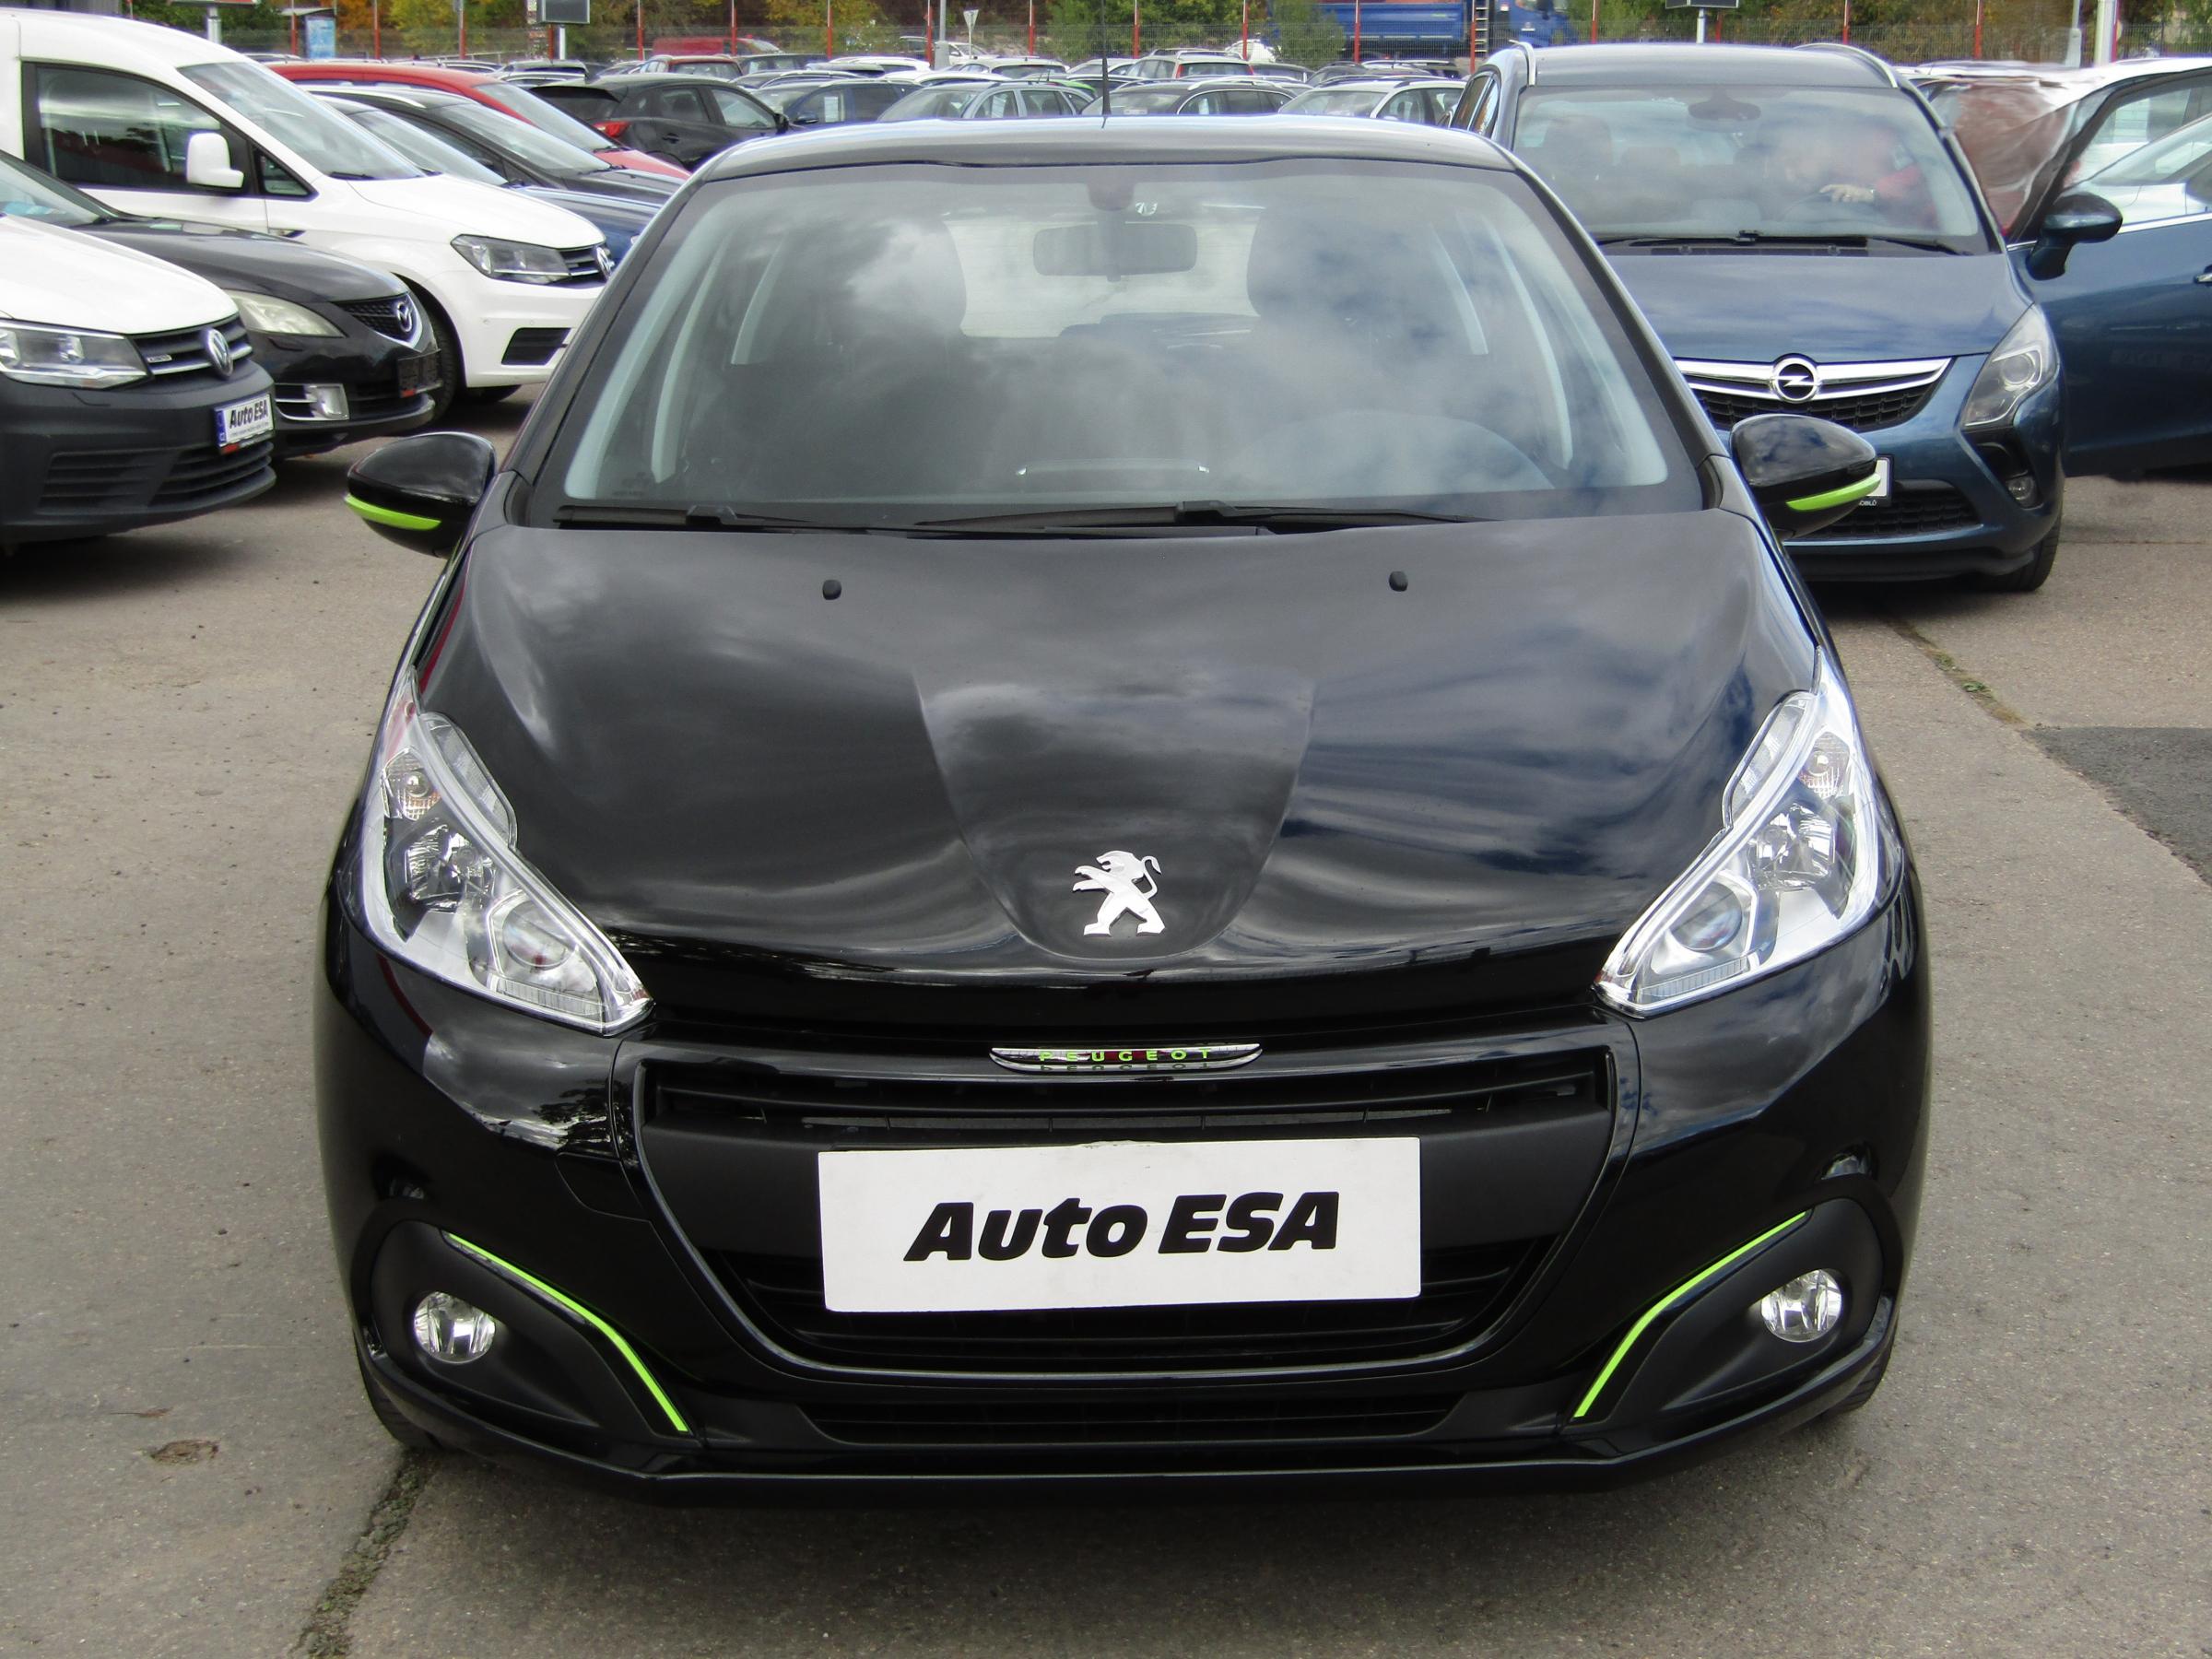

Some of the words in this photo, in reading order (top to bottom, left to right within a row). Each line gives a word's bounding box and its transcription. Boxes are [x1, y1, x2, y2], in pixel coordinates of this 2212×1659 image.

[229, 406, 253, 429] Auto
[254, 399, 268, 421] ESA
[1039, 1047, 1211, 1062] PEUGEOT
[903, 1197, 1147, 1261] Auto
[1158, 1191, 1339, 1253] ESA
